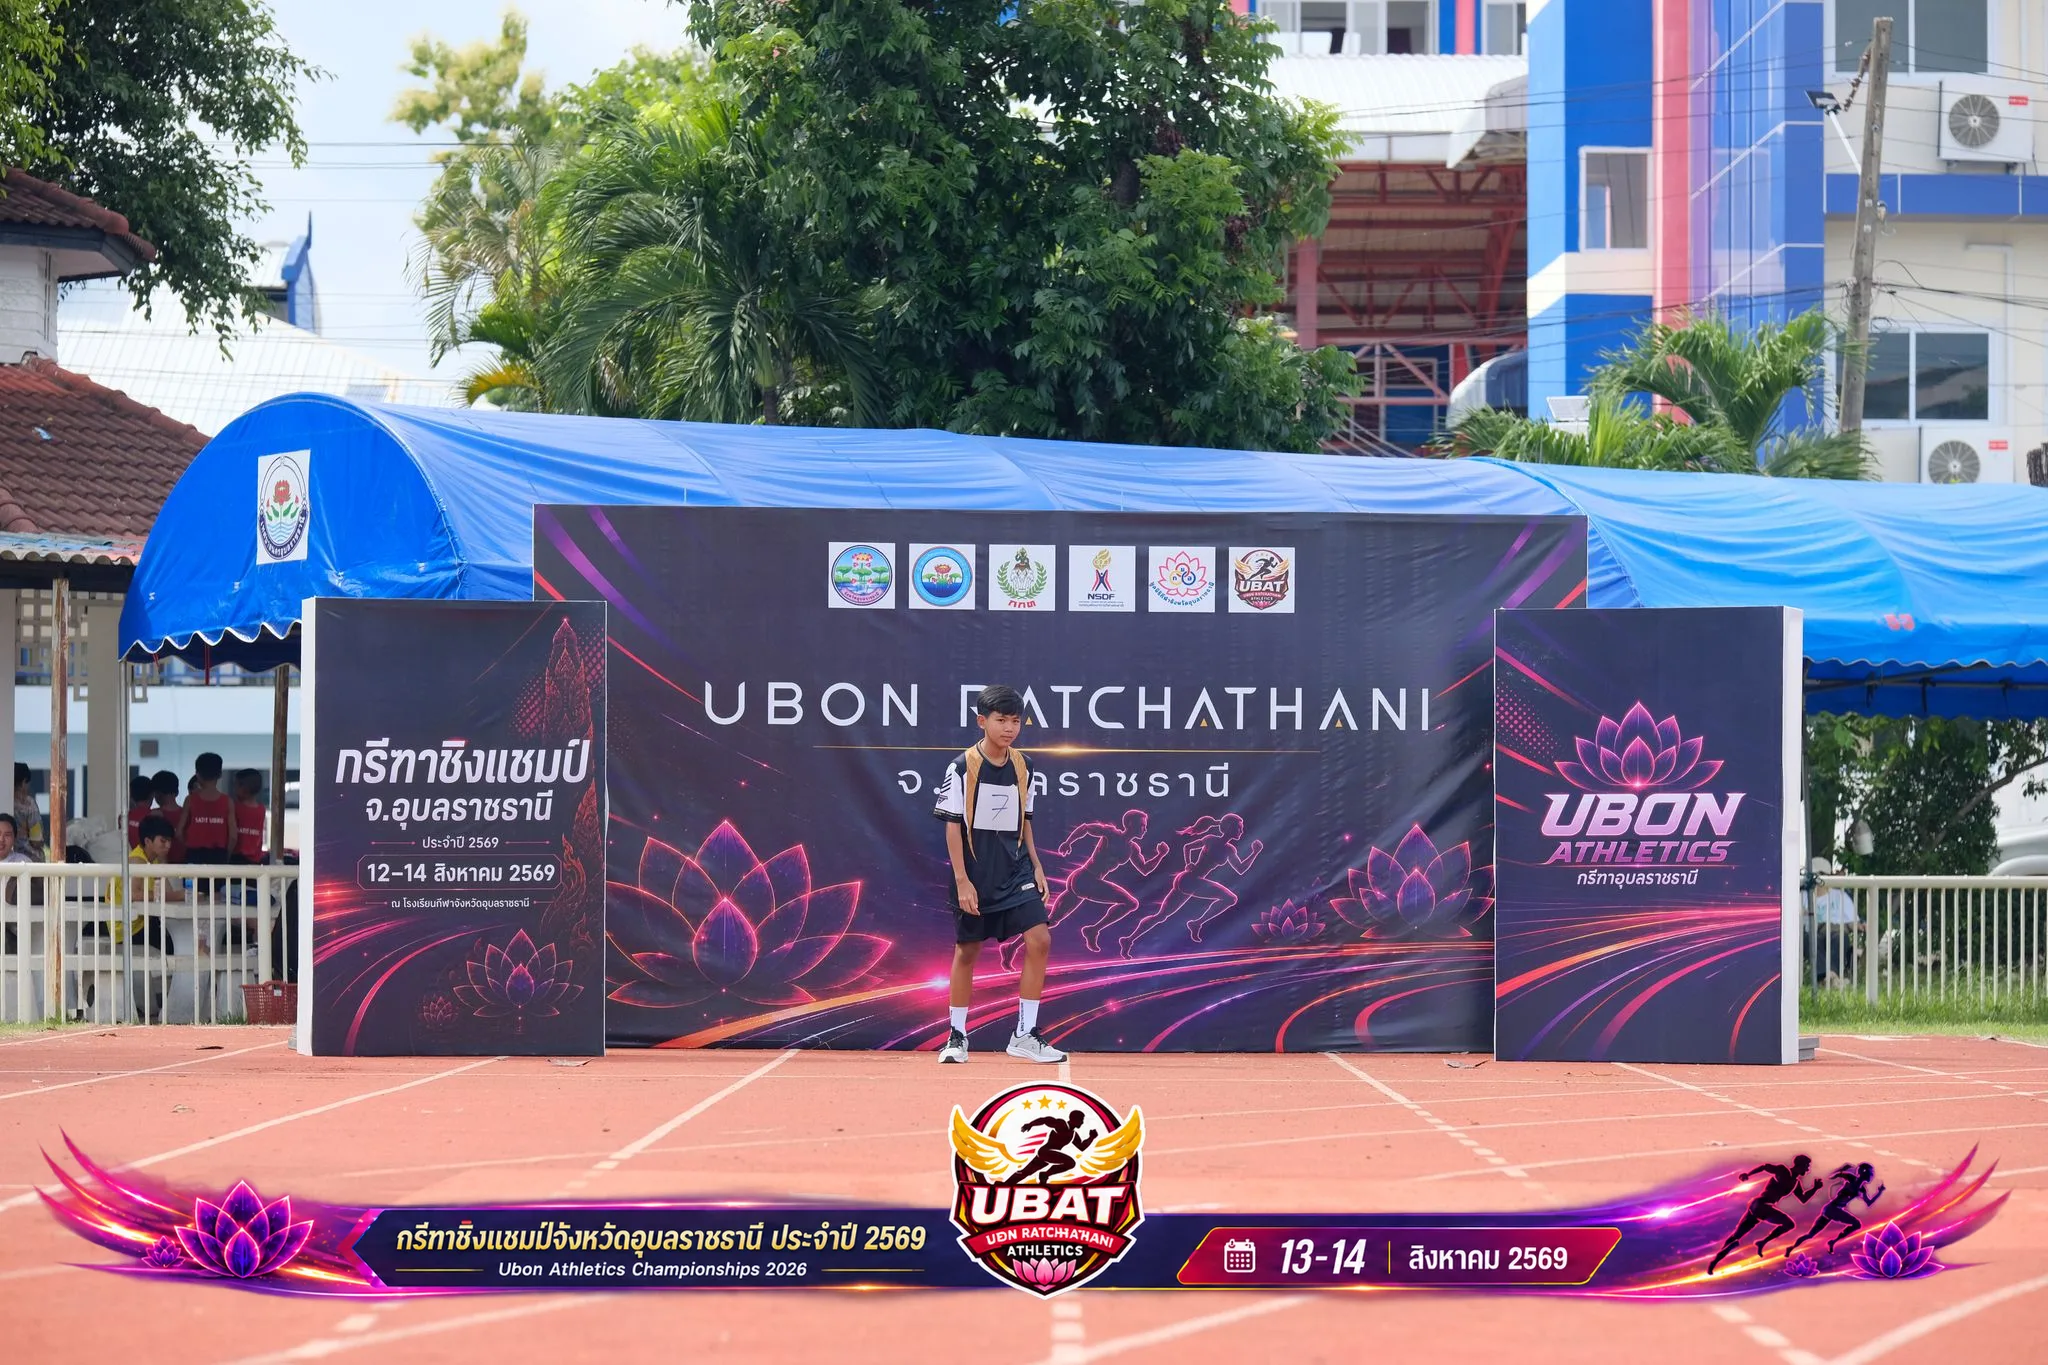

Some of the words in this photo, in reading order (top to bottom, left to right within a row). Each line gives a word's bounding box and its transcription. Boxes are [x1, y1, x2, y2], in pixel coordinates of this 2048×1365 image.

[1087, 593, 1115, 601] NSDF
[1239, 580, 1285, 592] UBAT
[705, 682, 918, 727] UBON
[335, 737, 590, 784] กรีฑาชิงแชมป์
[365, 789, 554, 831] จ.อุบลราชธานี
[991, 794, 1010, 822] 7
[1540, 792, 1747, 837] UBON
[422, 835, 465, 849] ประจำปี
[468, 837, 499, 849] 2569
[1543, 841, 1736, 865] ATHLETICS
[433, 862, 503, 882] สิงหาคม
[509, 863, 556, 882] 2569
[391, 900, 401, 908] ณ
